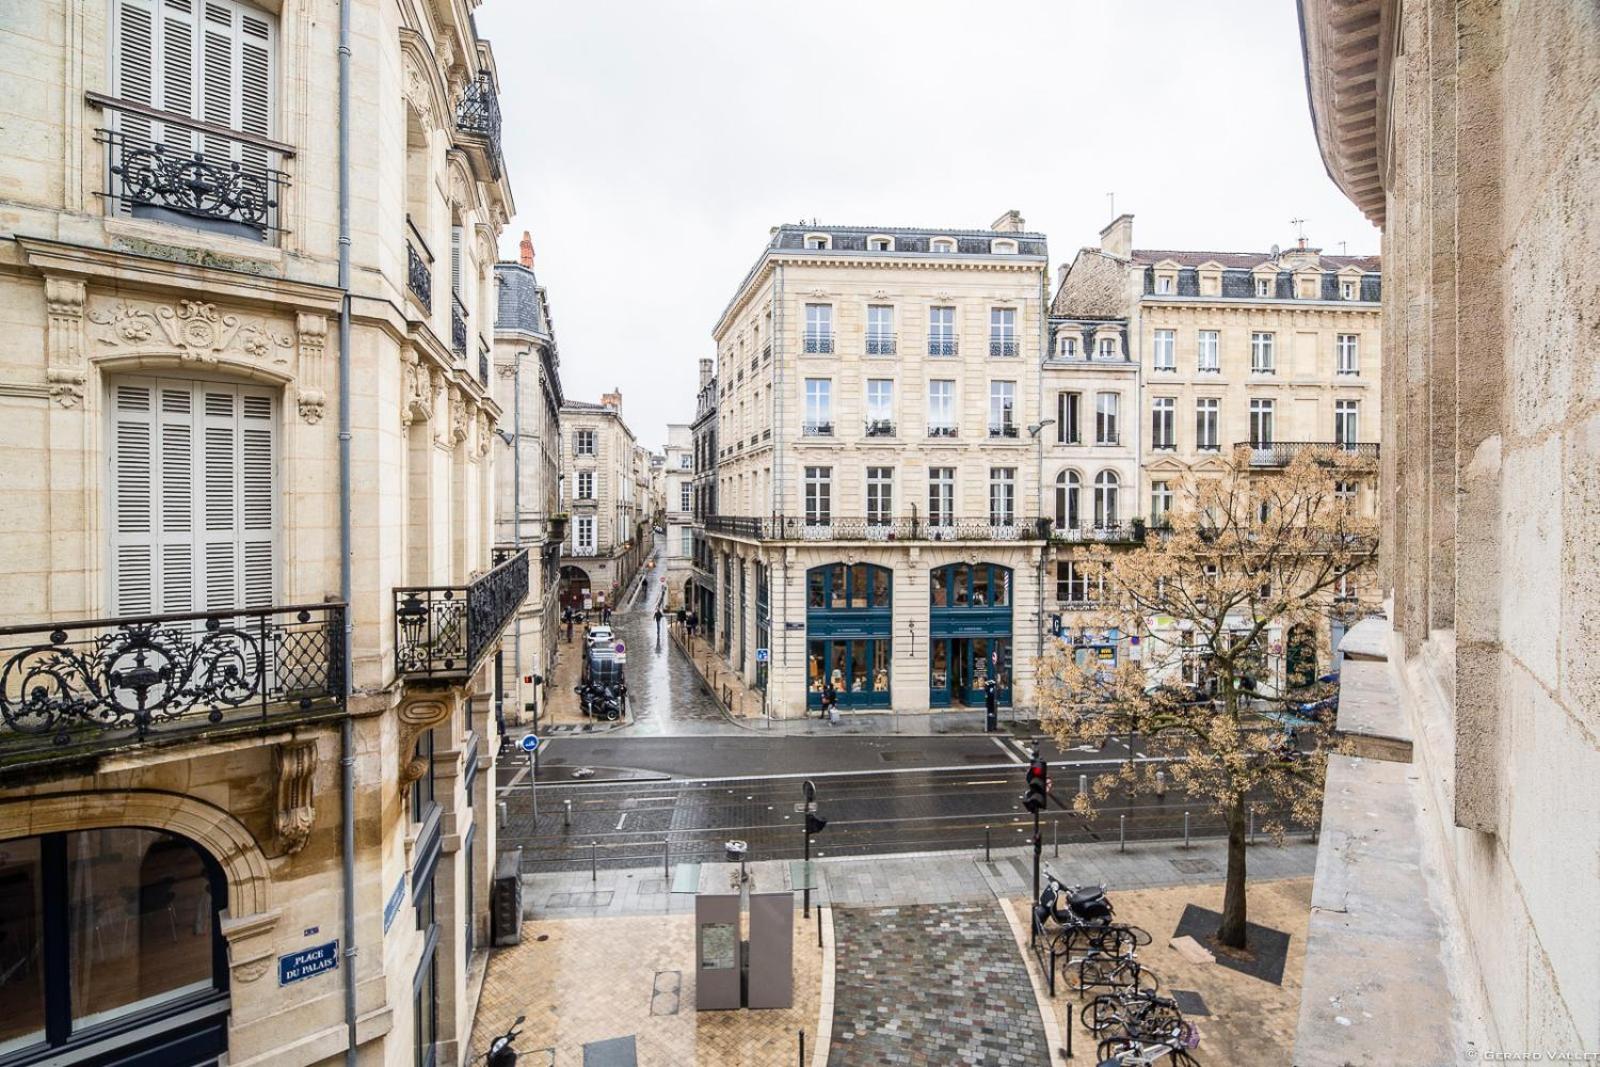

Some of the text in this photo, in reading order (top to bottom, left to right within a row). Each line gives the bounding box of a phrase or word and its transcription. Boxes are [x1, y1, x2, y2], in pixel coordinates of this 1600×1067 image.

[295, 949, 324, 965] PLACE
[286, 958, 333, 980] DU PALAIS
